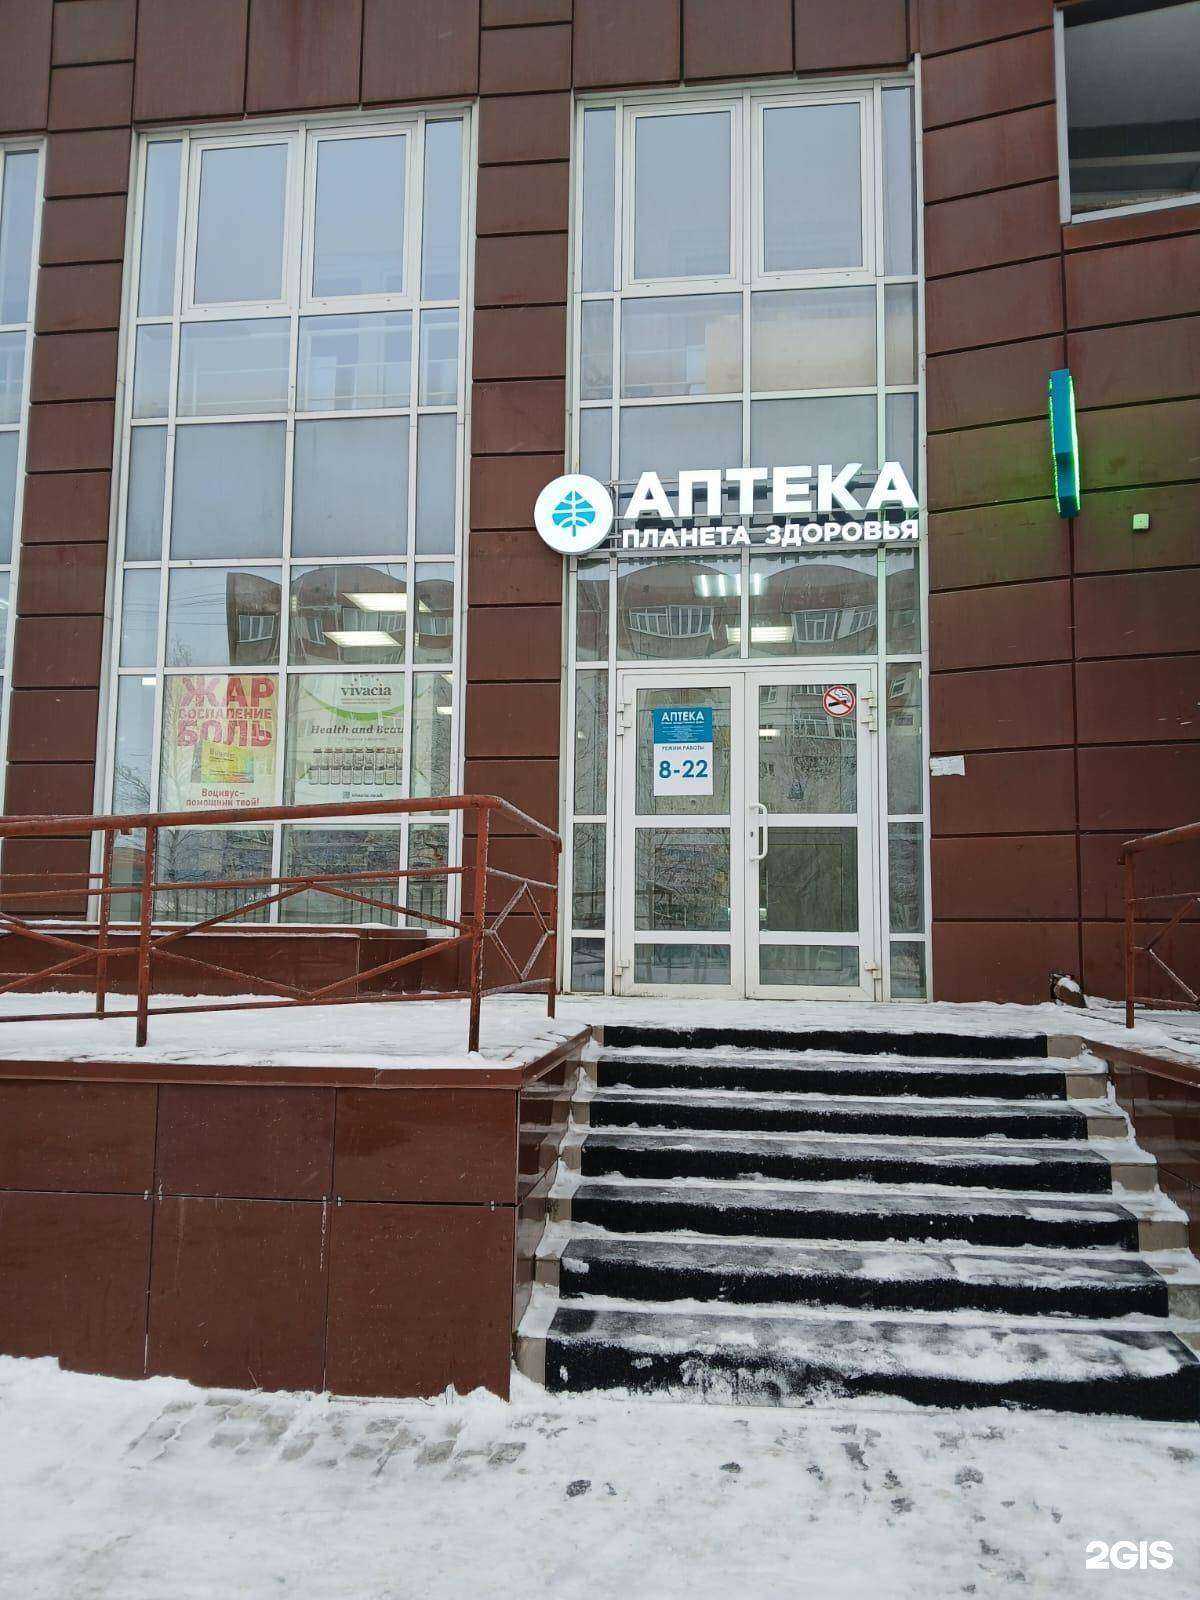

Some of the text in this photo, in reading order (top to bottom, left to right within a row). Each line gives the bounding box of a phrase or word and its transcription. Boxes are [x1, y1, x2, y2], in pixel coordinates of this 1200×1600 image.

[624, 461, 919, 518] АПТЕКА
[622, 519, 918, 548] ПЛАНЕТА ЗДОРОВЬЯ
[181, 677, 275, 707] ЖАР
[341, 684, 392, 696] vivacia
[661, 711, 704, 721] АПТЕКА
[178, 719, 273, 747] БОЛЬ
[311, 725, 349, 734] Health
[351, 725, 374, 734] and
[659, 760, 708, 778] 8-22
